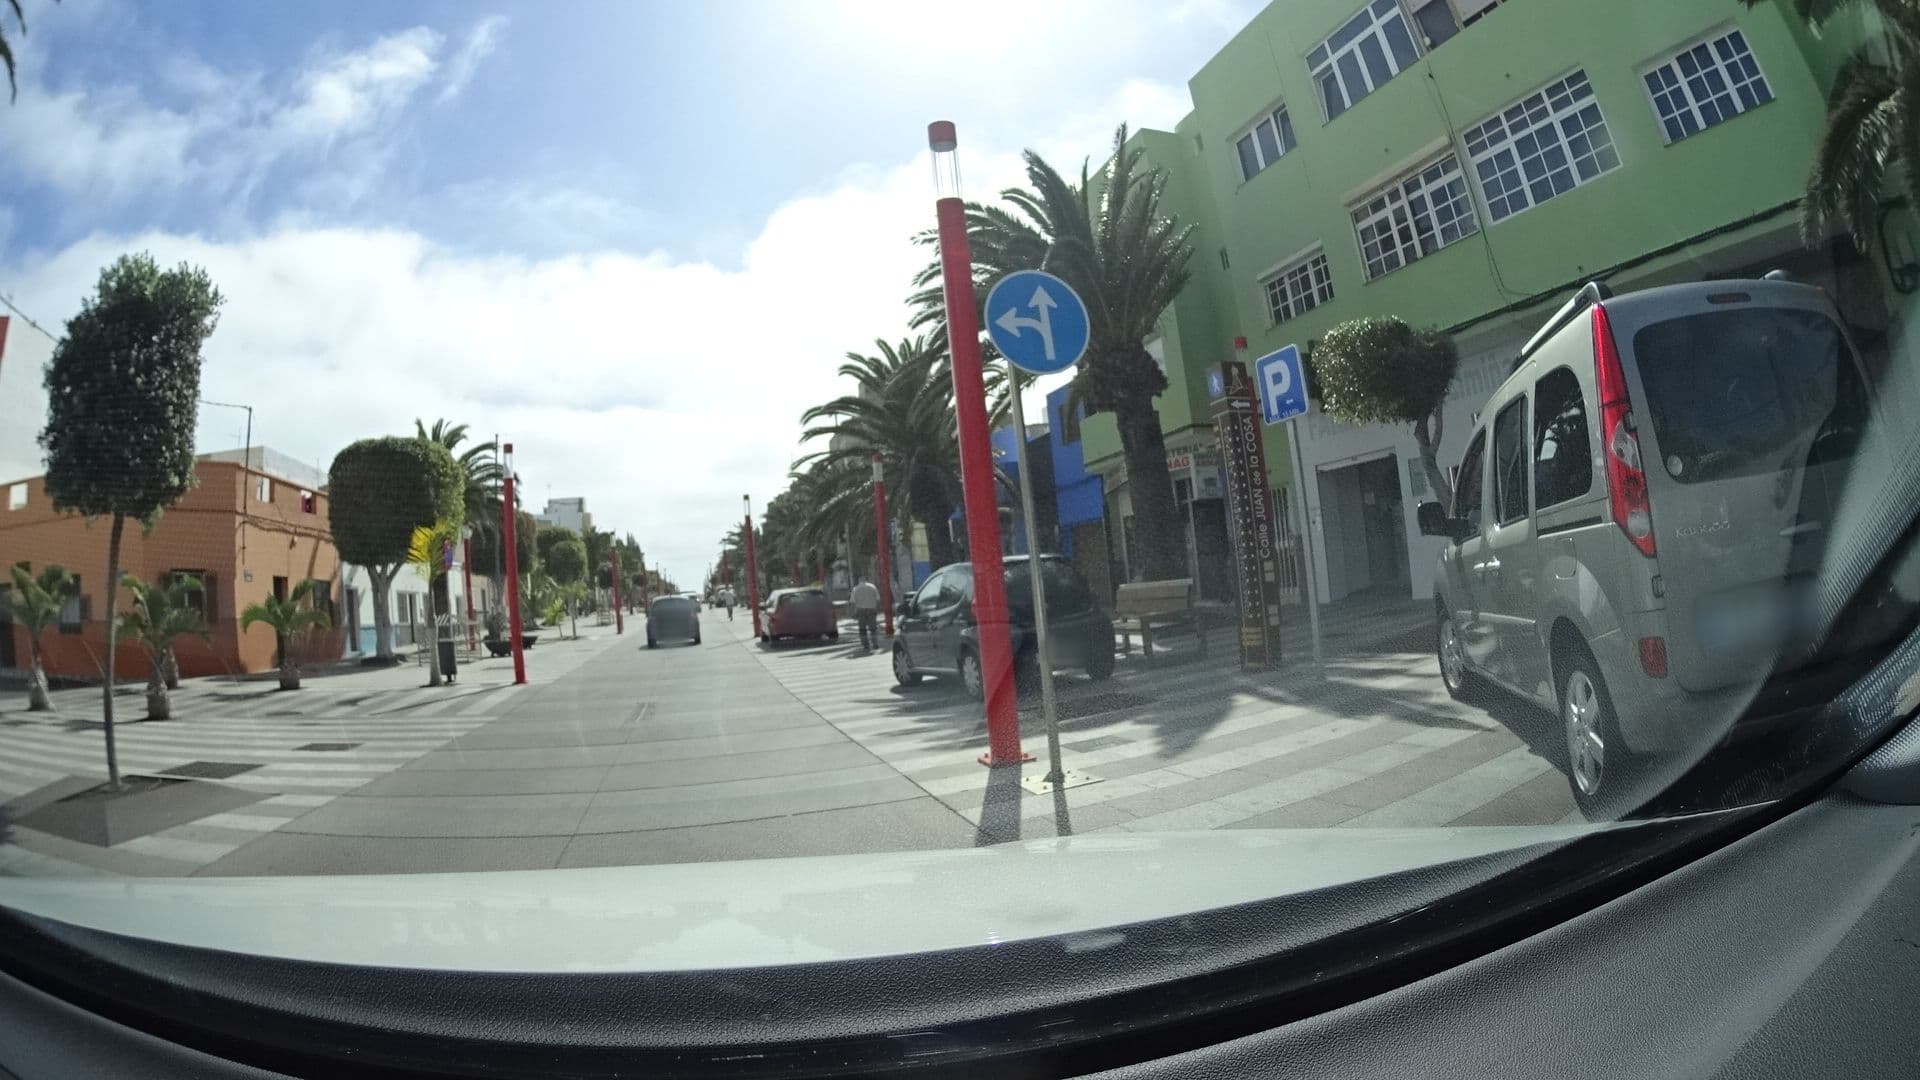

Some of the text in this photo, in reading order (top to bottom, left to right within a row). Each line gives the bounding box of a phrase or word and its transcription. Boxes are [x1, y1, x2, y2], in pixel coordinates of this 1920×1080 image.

[1263, 360, 1291, 416] P
[1243, 416, 1271, 559] Calle JUAN de la COSA
